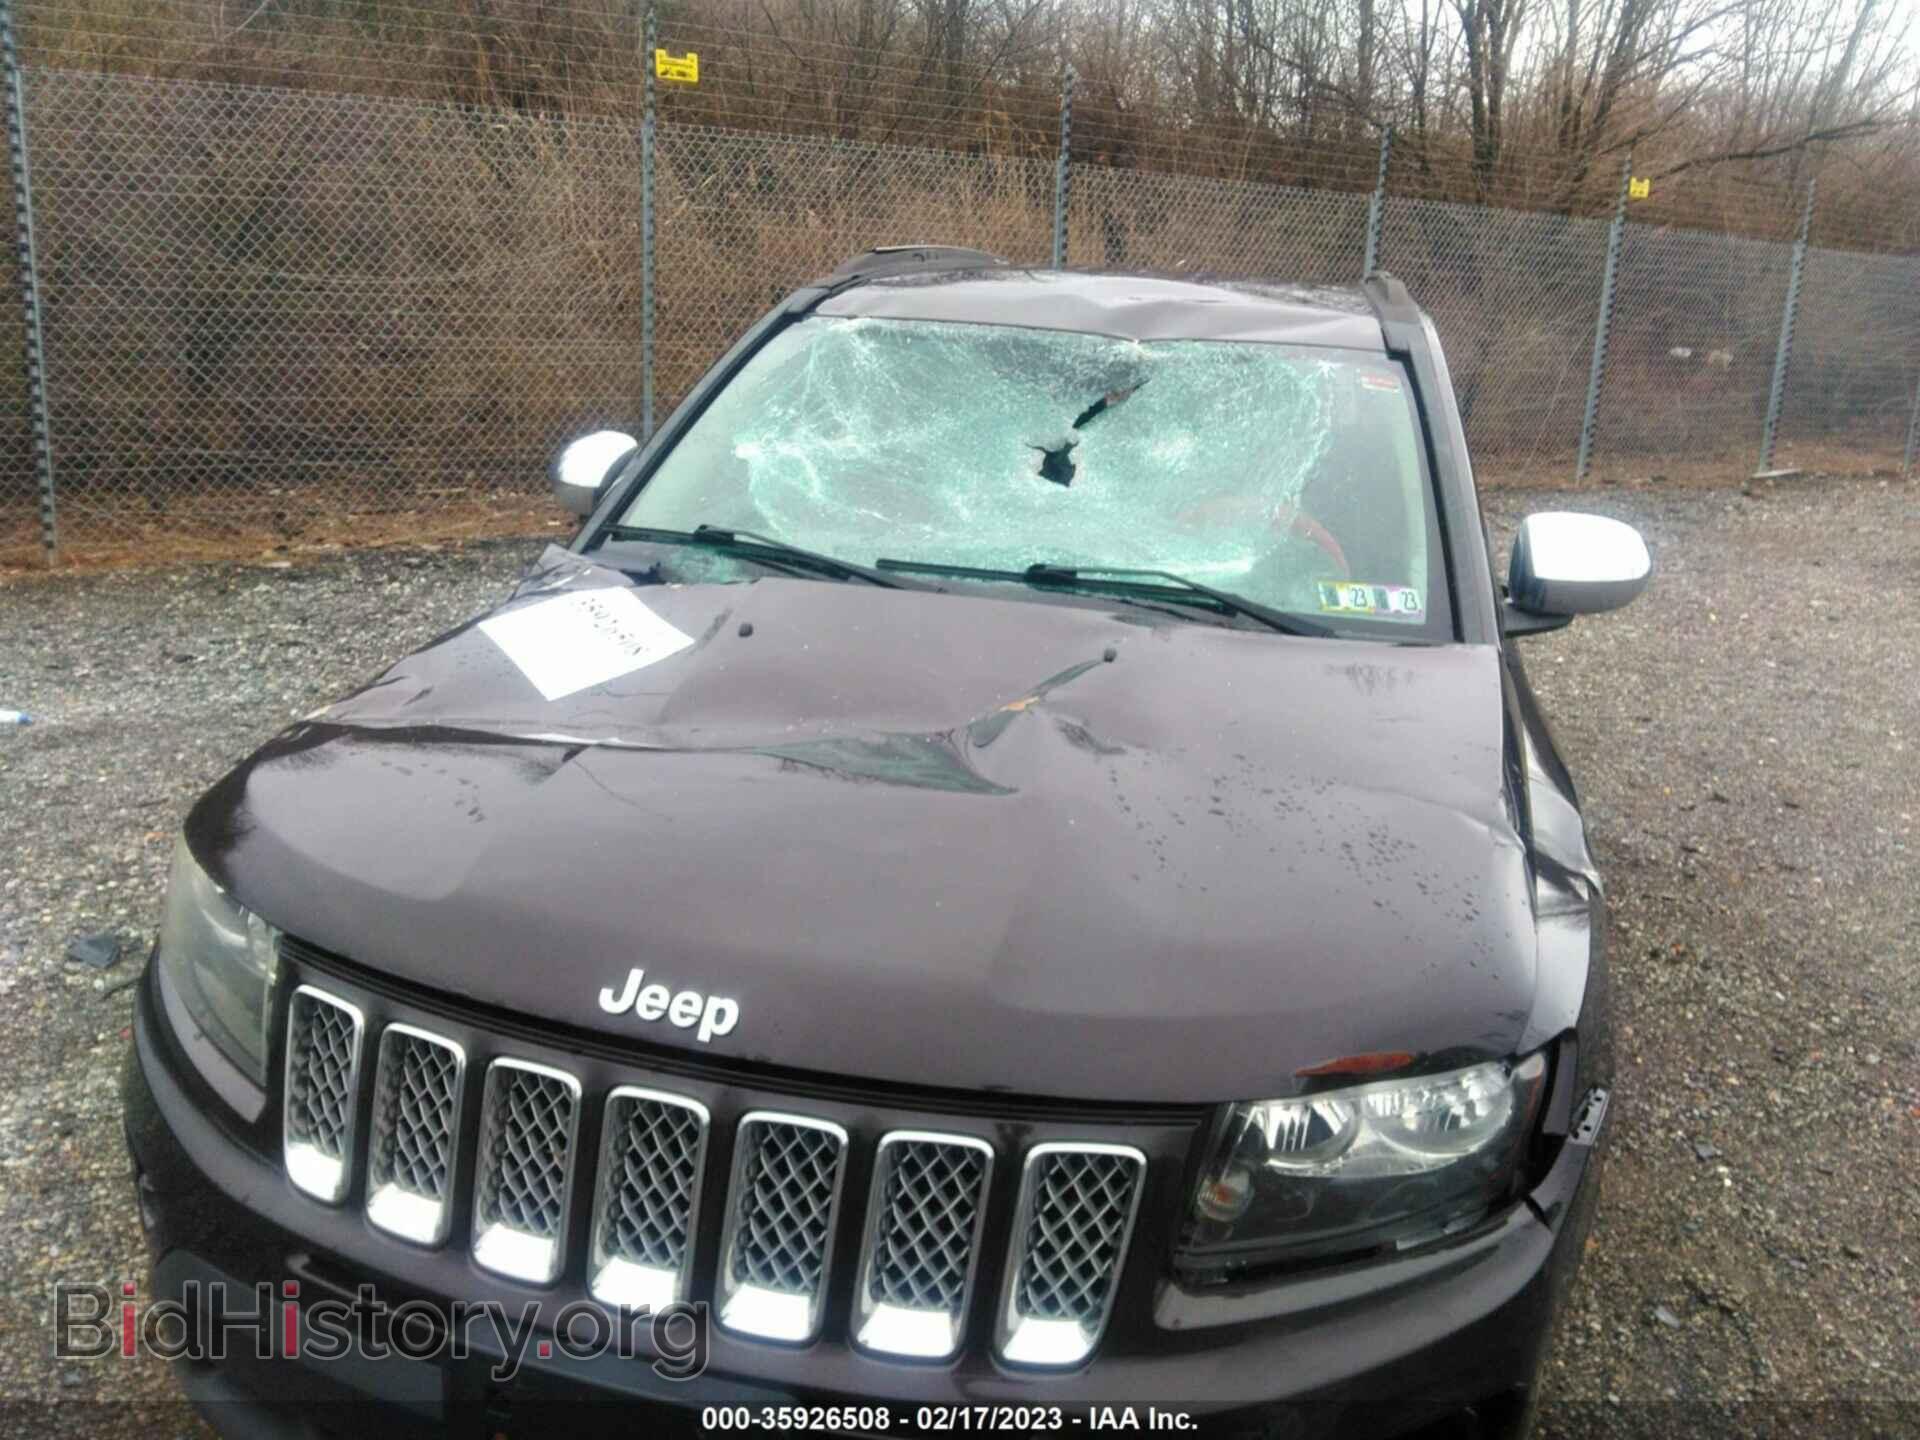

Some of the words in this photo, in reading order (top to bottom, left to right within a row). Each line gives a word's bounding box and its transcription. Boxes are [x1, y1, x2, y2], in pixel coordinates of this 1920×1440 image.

[1351, 587, 1368, 608] 23
[1401, 591, 1418, 611] 23
[598, 968, 740, 1043] Jeep
